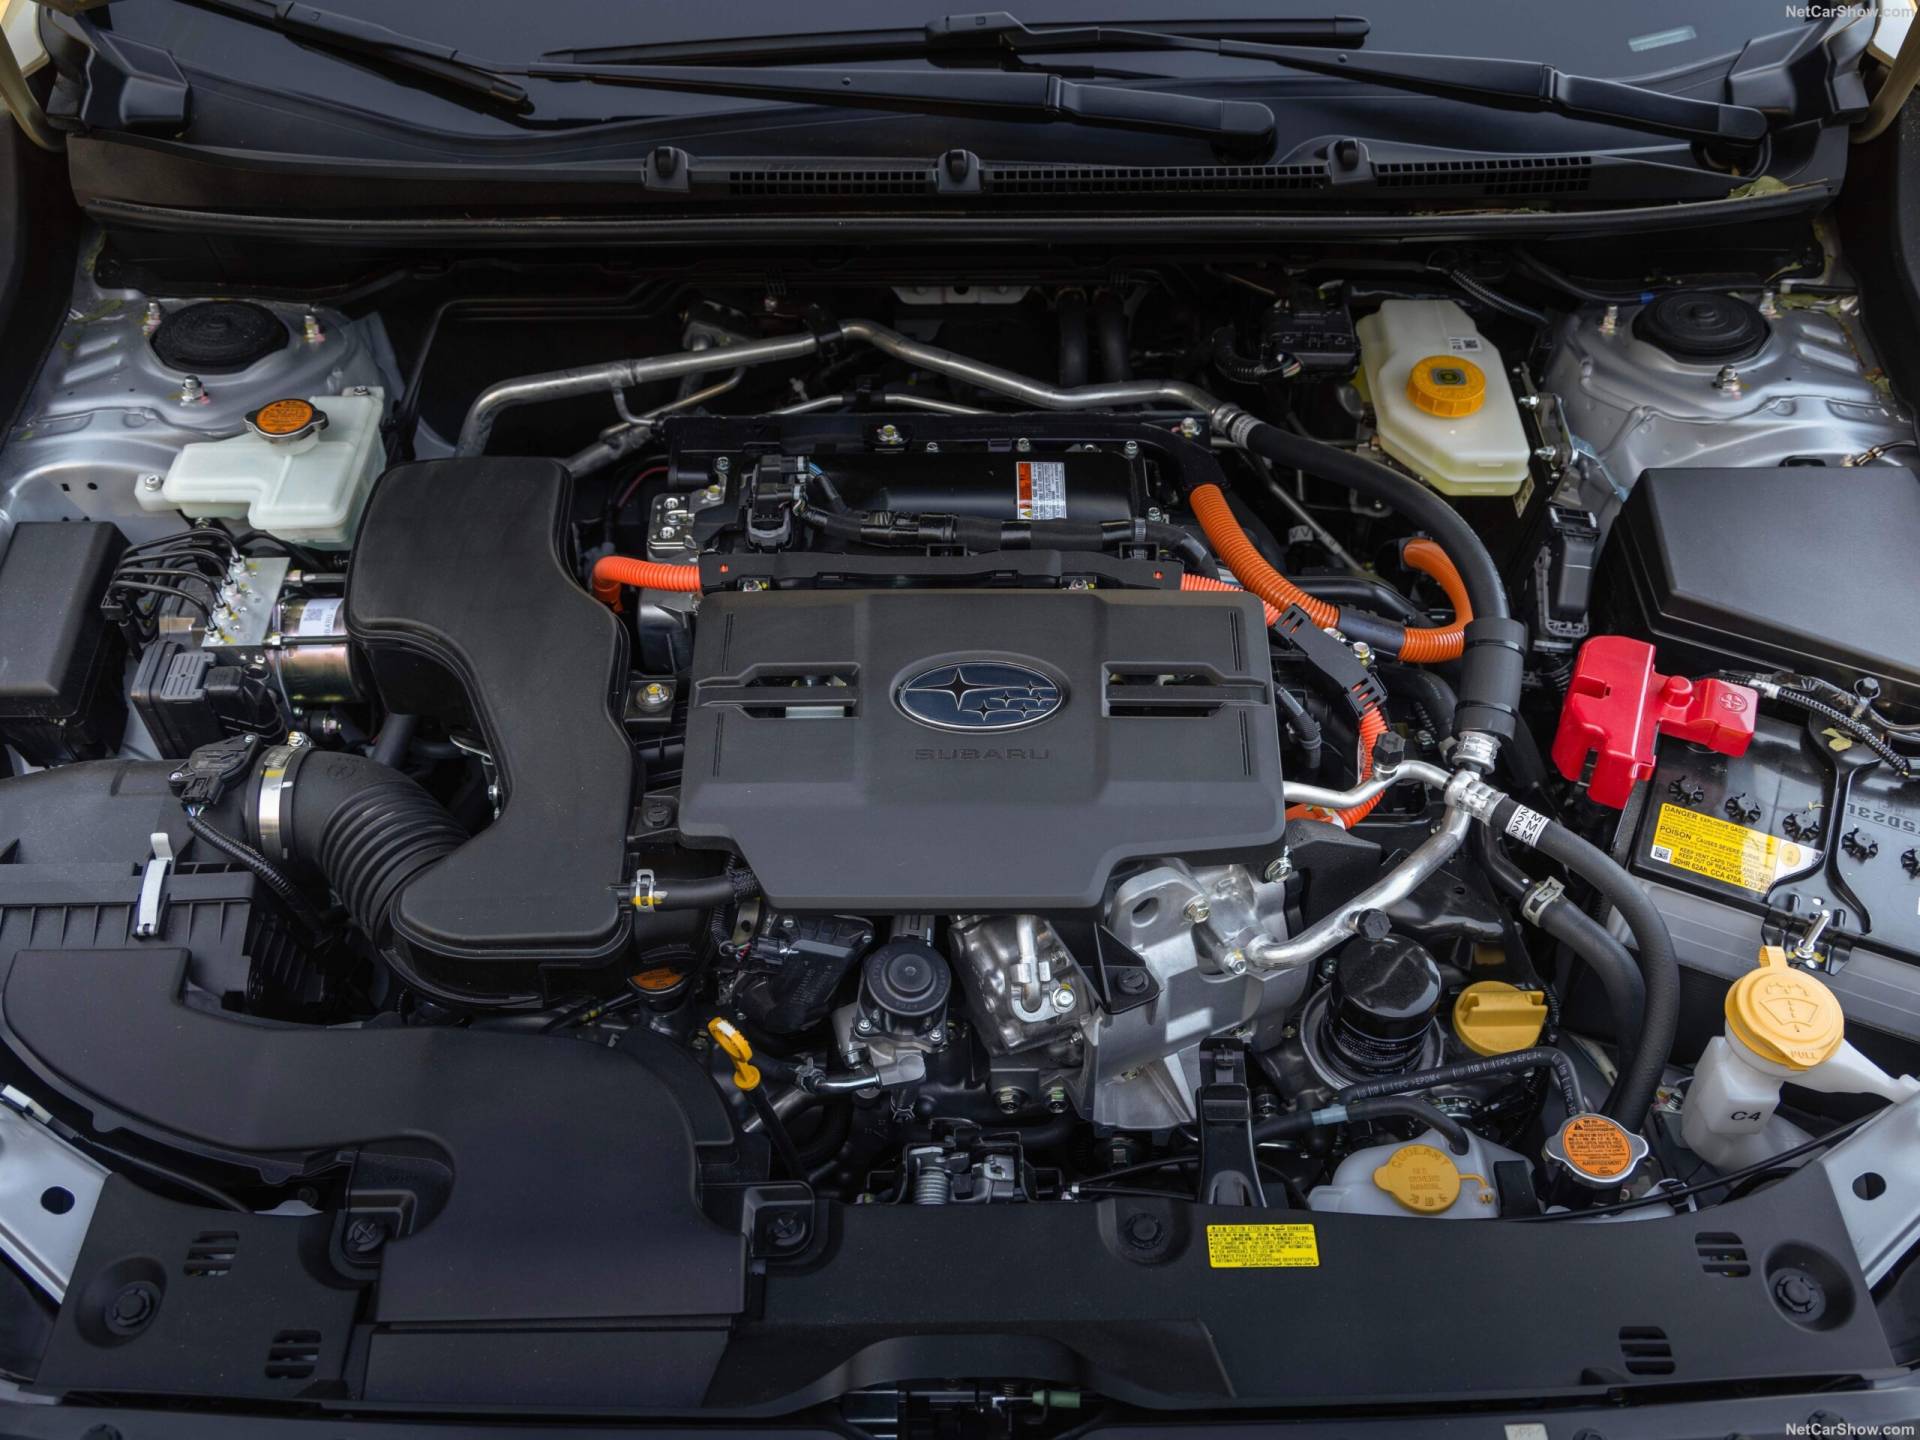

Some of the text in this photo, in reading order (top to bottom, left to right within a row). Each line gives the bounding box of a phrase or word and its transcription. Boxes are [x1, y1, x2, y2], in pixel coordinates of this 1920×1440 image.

[914, 748, 1049, 760] SUBARU
[1664, 805, 1698, 821] DANGER
[1847, 802, 1920, 835] 5D23L
[1659, 825, 1692, 841] POISON
[1731, 1111, 1761, 1121] C4
